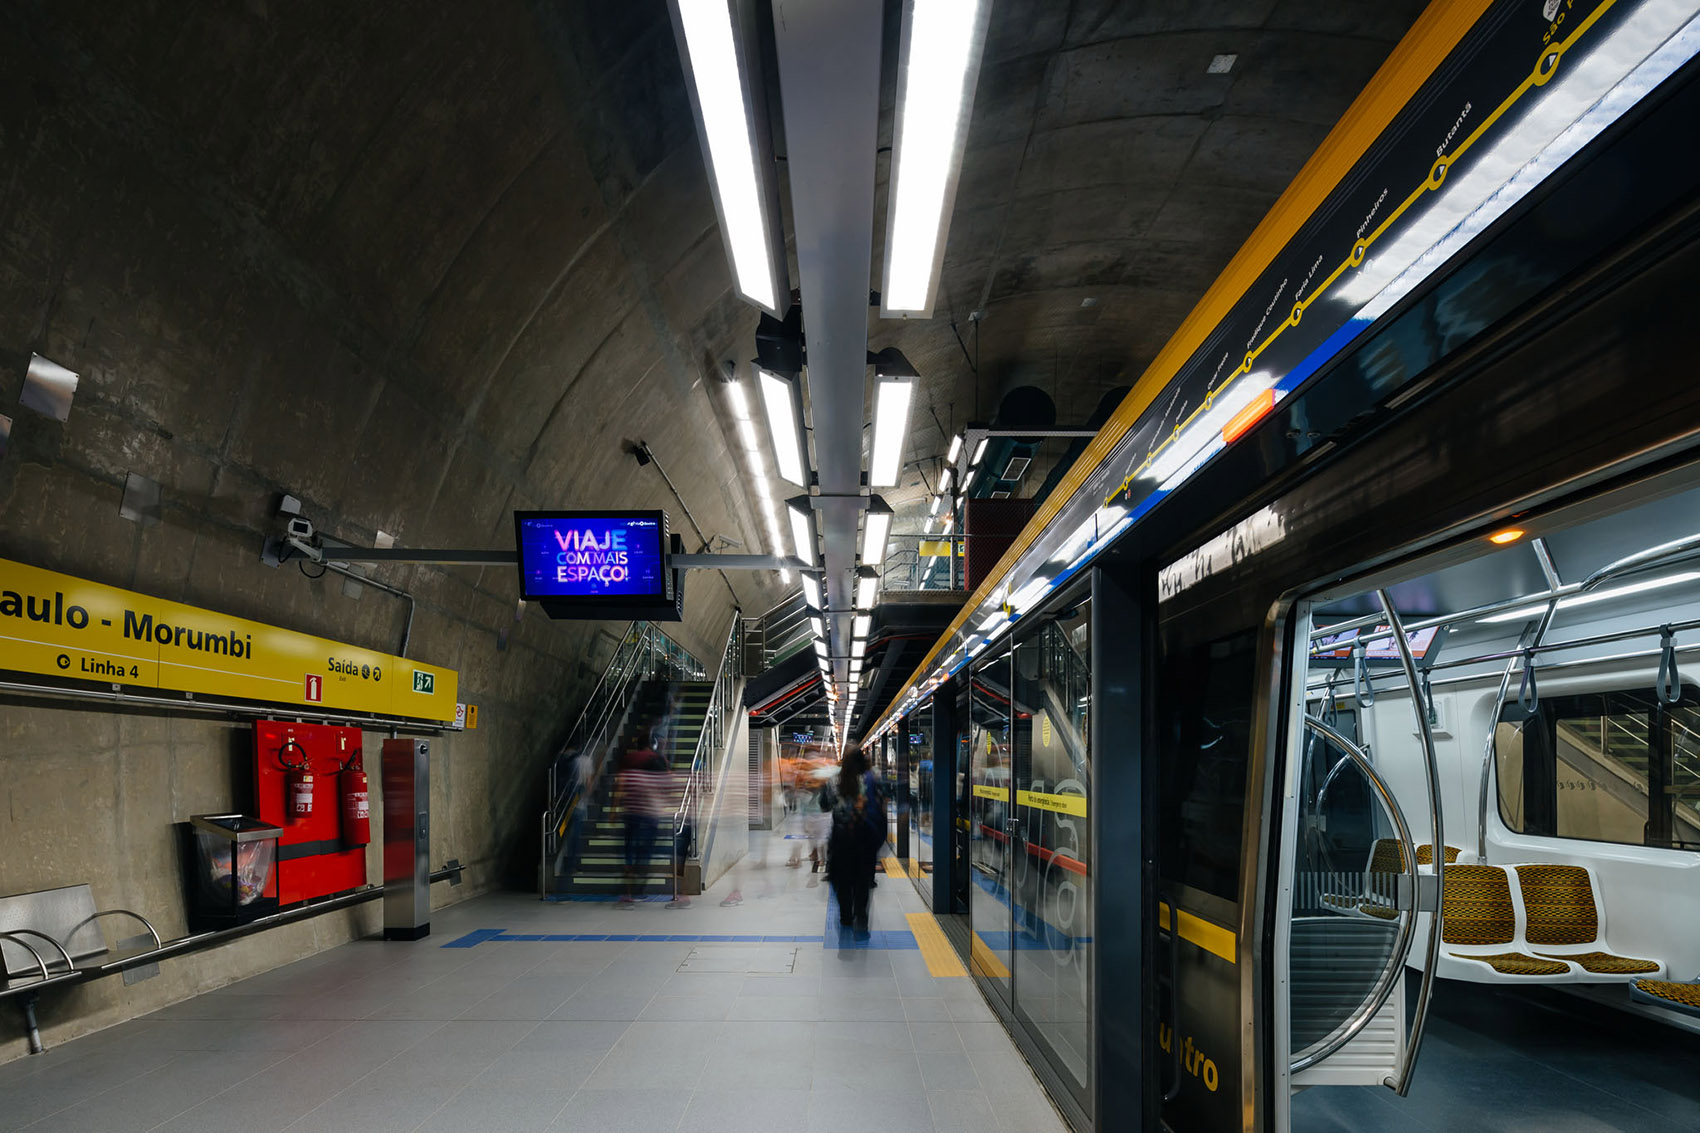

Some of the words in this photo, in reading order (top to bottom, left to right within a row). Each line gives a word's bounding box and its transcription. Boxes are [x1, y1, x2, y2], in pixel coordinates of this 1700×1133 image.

[1543, 12, 1566, 45] São
[1435, 101, 1473, 157] Butantã
[1356, 188, 1389, 239] Pinheiros
[554, 529, 628, 551] VIAJE
[556, 551, 591, 565] COM
[593, 551, 628, 565] MAIS
[557, 565, 629, 587] ESPAÇO!
[0, 591, 89, 629] aulo
[123, 609, 251, 659] Morumbi
[81, 657, 125, 677] Linha
[129, 665, 139, 678] 4
[328, 657, 359, 676] Saída
